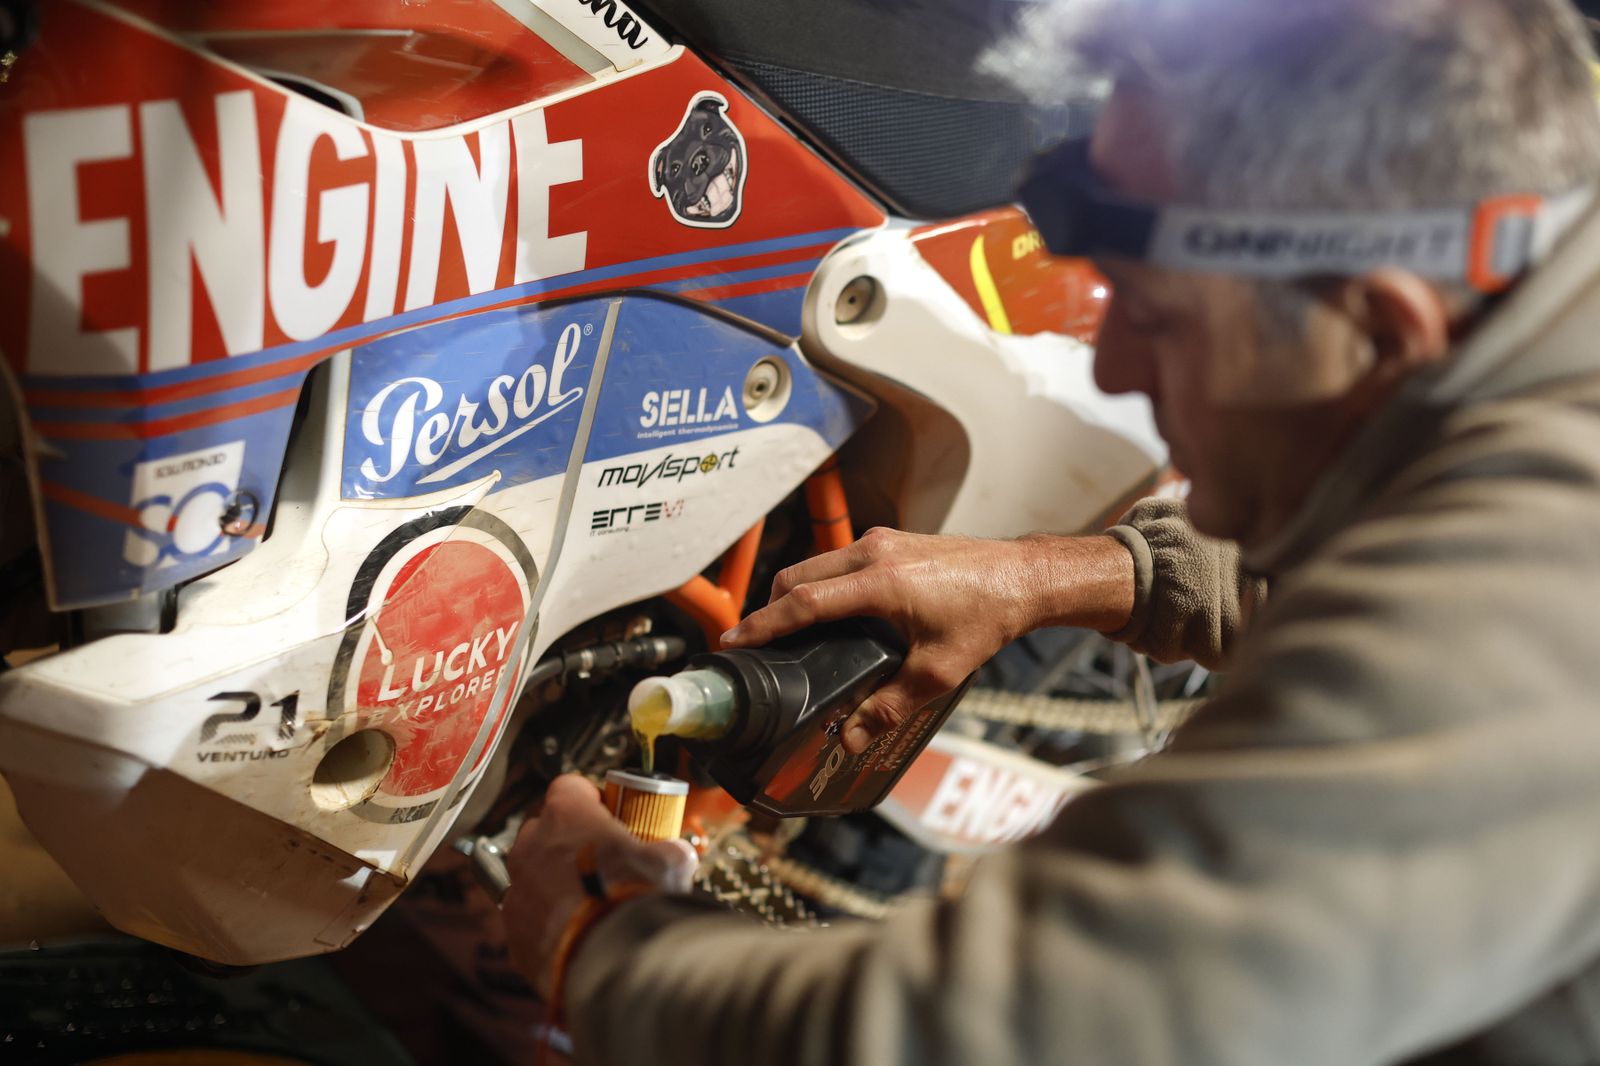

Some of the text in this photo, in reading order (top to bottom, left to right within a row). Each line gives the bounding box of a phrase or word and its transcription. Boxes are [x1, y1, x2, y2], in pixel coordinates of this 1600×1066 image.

[24, 91, 588, 376] ENGINE
[360, 323, 584, 485] Persol
[640, 385, 739, 428] SELLA
[377, 620, 520, 702] LUCKY
[199, 688, 301, 745] 21
